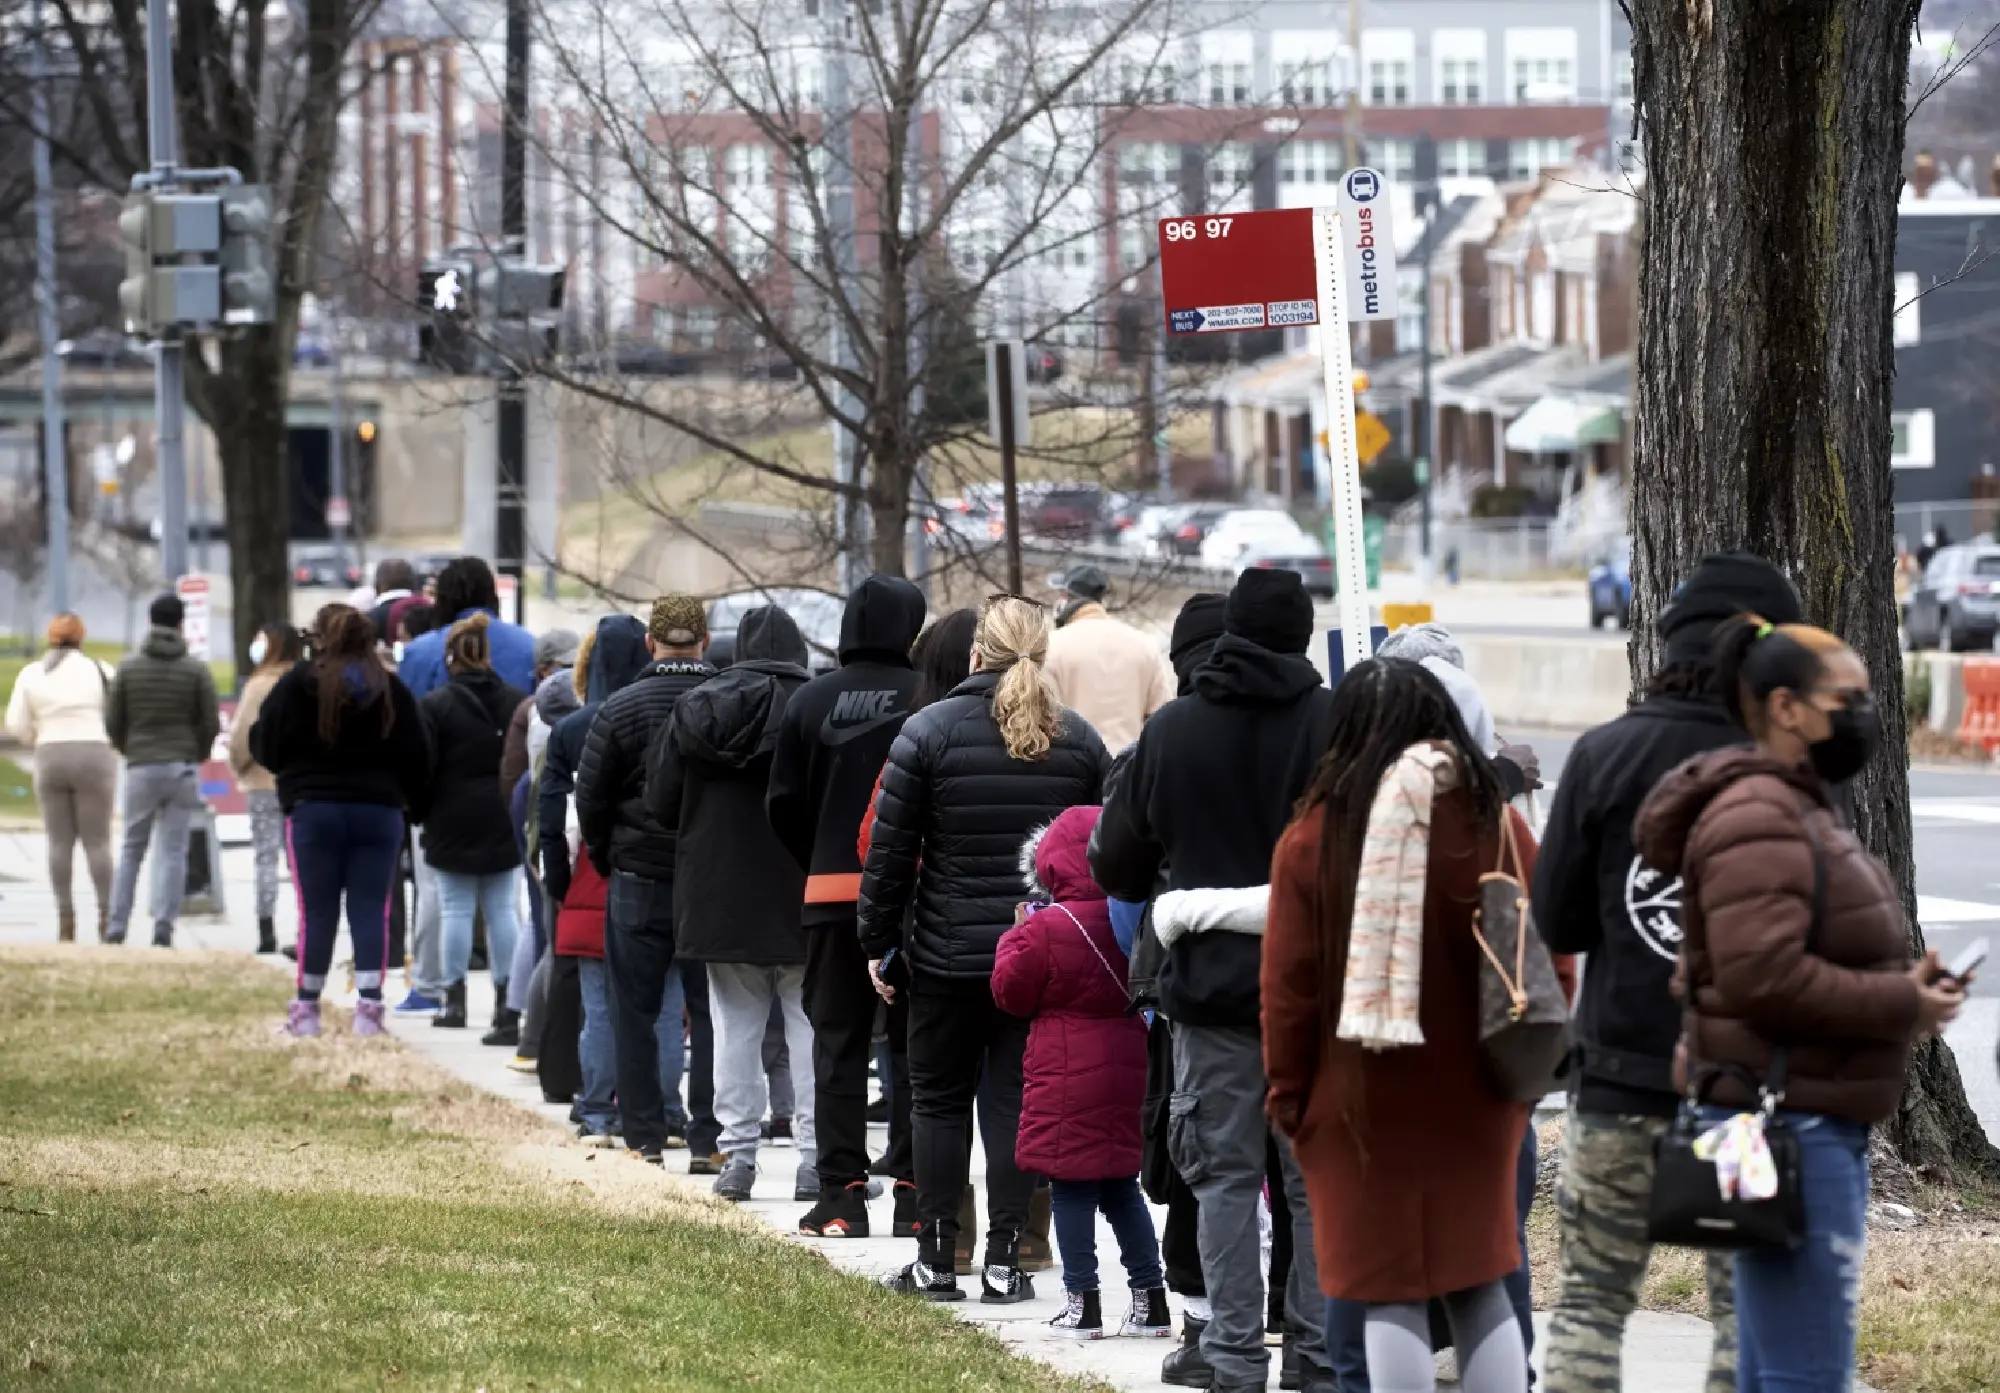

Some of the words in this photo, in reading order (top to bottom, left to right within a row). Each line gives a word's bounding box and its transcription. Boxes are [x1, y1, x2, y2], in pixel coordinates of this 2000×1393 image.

[1165, 221, 1197, 242] 96
[1205, 218, 1233, 239] 97
[1356, 207, 1378, 314] metrobus
[1268, 303, 1288, 313] STOP
[1290, 302, 1299, 311] ID
[1171, 311, 1195, 321] NEXT
[1207, 316, 1264, 327] WMATA.COM
[1270, 311, 1314, 324] 1003194
[1175, 321, 1194, 331] BUS
[833, 690, 898, 720] NIKE
